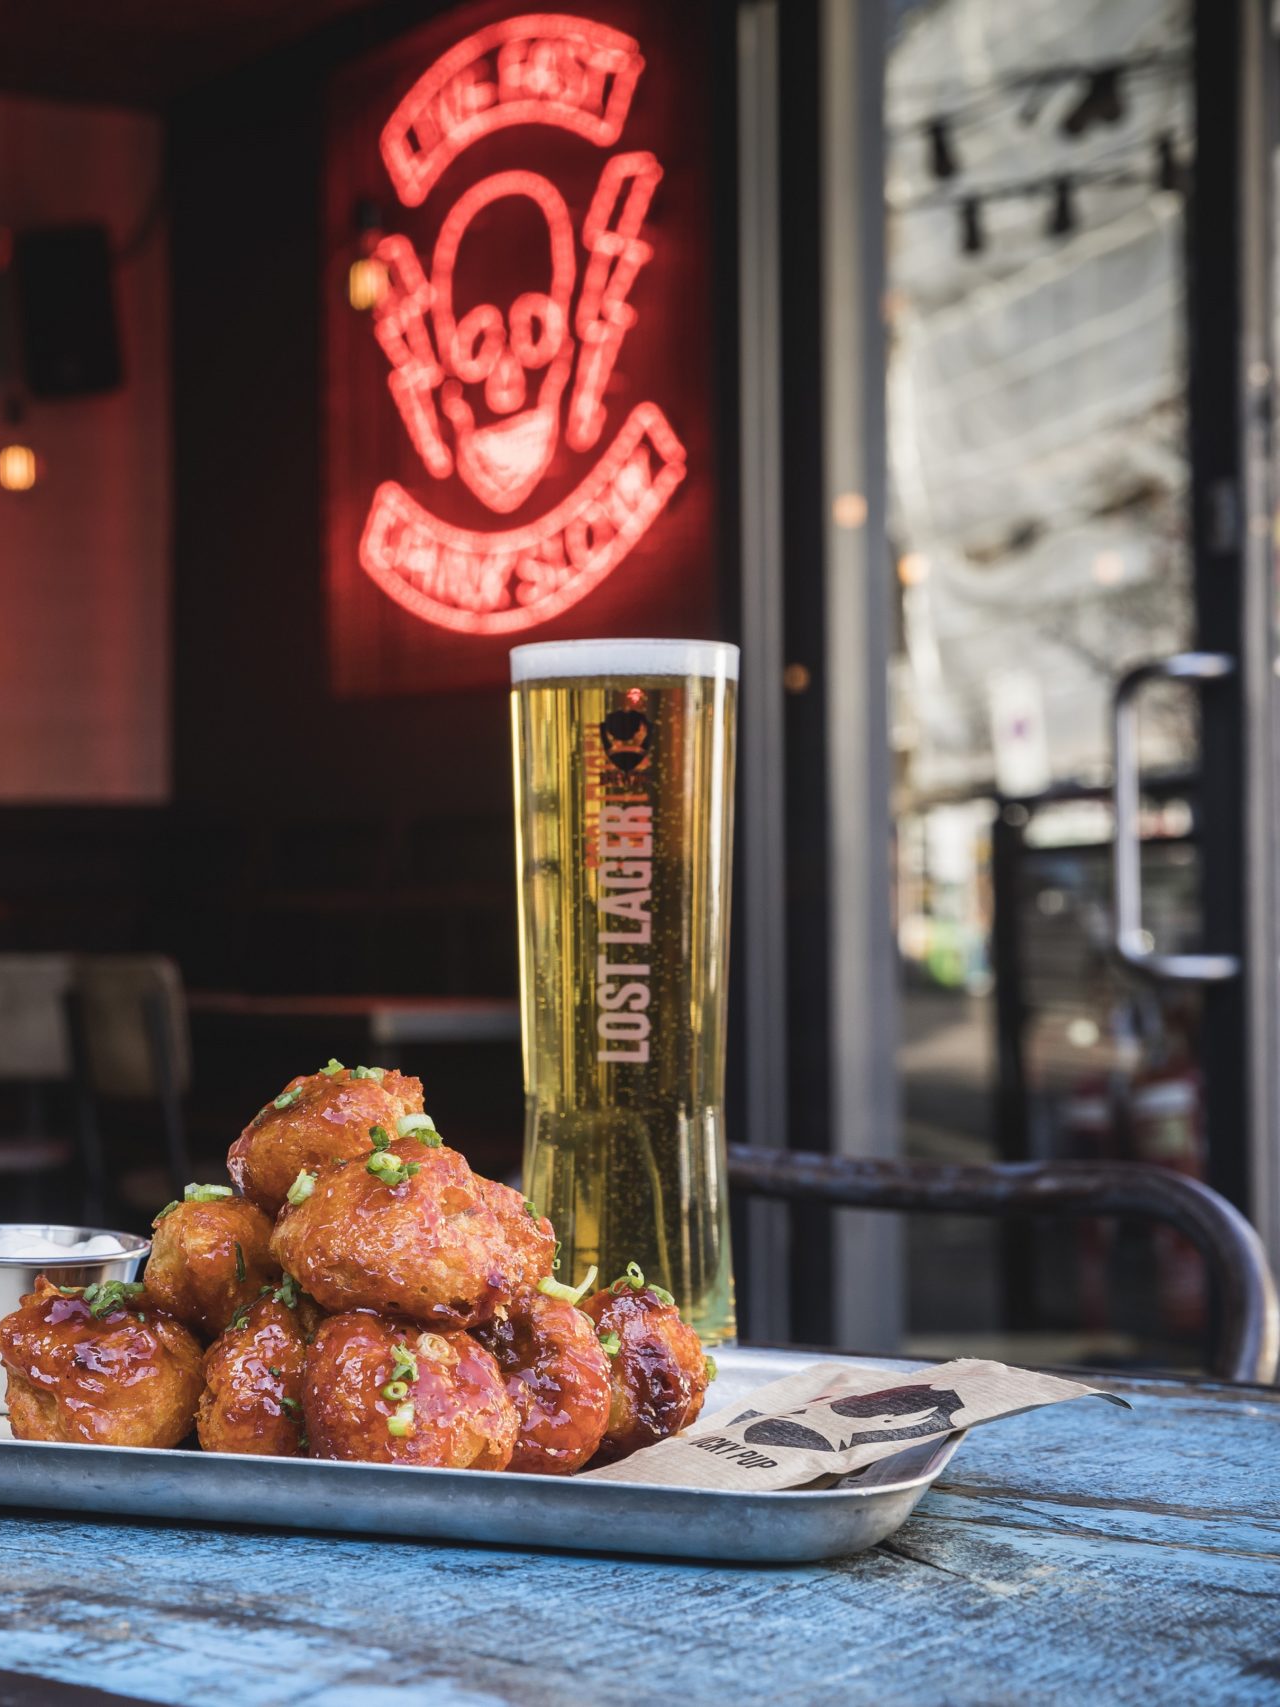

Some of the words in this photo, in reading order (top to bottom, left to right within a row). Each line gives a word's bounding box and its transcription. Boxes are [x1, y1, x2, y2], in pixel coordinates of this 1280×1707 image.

[597, 805, 654, 945] LAGER
[597, 955, 652, 1064] LOST
[725, 1450, 779, 1469] PUP
